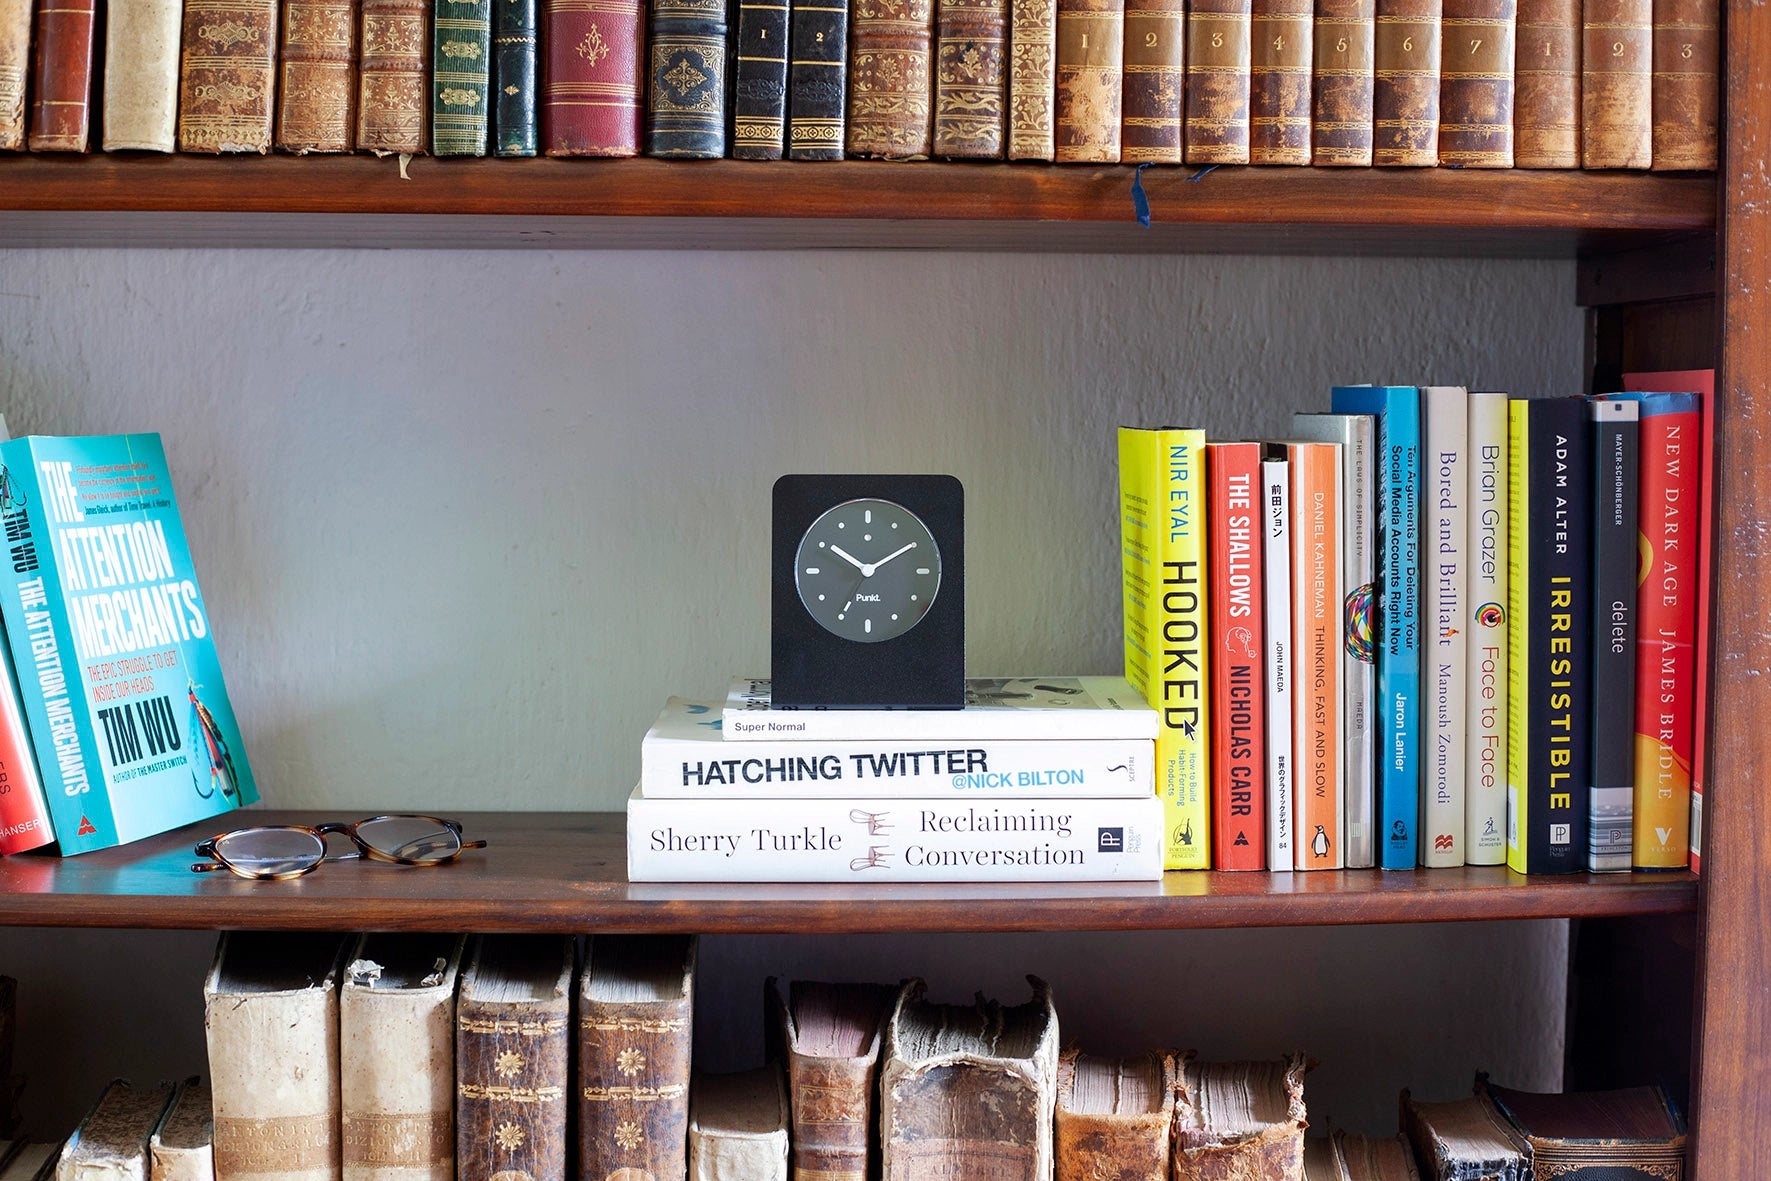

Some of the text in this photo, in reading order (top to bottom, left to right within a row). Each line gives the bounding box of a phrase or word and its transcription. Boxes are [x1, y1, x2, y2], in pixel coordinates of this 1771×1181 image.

[816, 32, 824, 43] 2
[1145, 32, 1158, 47] 2
[1212, 32, 1223, 48] 3
[1272, 34, 1285, 51] 4
[1336, 36, 1348, 52] 5
[1403, 36, 1413, 52] 6
[1470, 39, 1482, 55] 7
[1612, 42, 1625, 58] 2
[1681, 43, 1693, 59] 3
[40, 461, 84, 523] THE
[1170, 446, 1189, 543] NIR EYAL
[1271, 484, 1282, 538] 前田ジョン
[1356, 488, 1363, 499] OF
[1482, 446, 1500, 584] Brian Grazer
[1556, 435, 1568, 555] ADAM ALTER
[3, 509, 40, 574] TIM WU
[58, 520, 174, 591] ATTENTION
[1229, 473, 1251, 617] THE SHALLOWS
[1388, 445, 1402, 656] Social Media Accounts Right Now
[1405, 445, 1416, 650] Ten Arguments For Deleting Your
[1439, 451, 1457, 647] Bored and Brilliant
[68, 580, 206, 659] MERCHANTS
[855, 593, 881, 602] Punkt.
[1658, 425, 1681, 800] NEW DARK AGE JAMES BRIDLE
[1162, 561, 1199, 730] HOOKED
[1314, 492, 1327, 798] DANIEL KAHNEMAN THINKING, FAST AND SLOW
[1611, 601, 1628, 654] delete
[17, 576, 90, 797] THE ATTENTION MERCHANTS
[88, 650, 179, 682] THE EPIC STRUGGLE TO GET
[92, 676, 155, 703] INSIDE OUR HEADS
[1550, 576, 1571, 809] IRRESISTIBLE
[98, 695, 182, 766] TIM WU
[734, 721, 806, 735] Super Normal
[1231, 666, 1251, 817] NICHOLAS CARR
[1395, 692, 1405, 772] Jaron Lanier
[1438, 664, 1451, 804] Manoush Zomorodi
[1481, 647, 1499, 788] Face to Face
[138, 767, 147, 777] THE
[147, 761, 166, 776] MASTER
[167, 755, 188, 771] SWITCH
[681, 749, 988, 788] HATCHING TWITTER
[952, 768, 1085, 791] @NICK BILTON
[1168, 759, 1176, 797] Products
[1189, 753, 1197, 802] How to Build
[650, 826, 842, 858] Sherry Turkle
[919, 809, 1073, 838] Reclaiming
[904, 844, 1085, 867] Conversation
